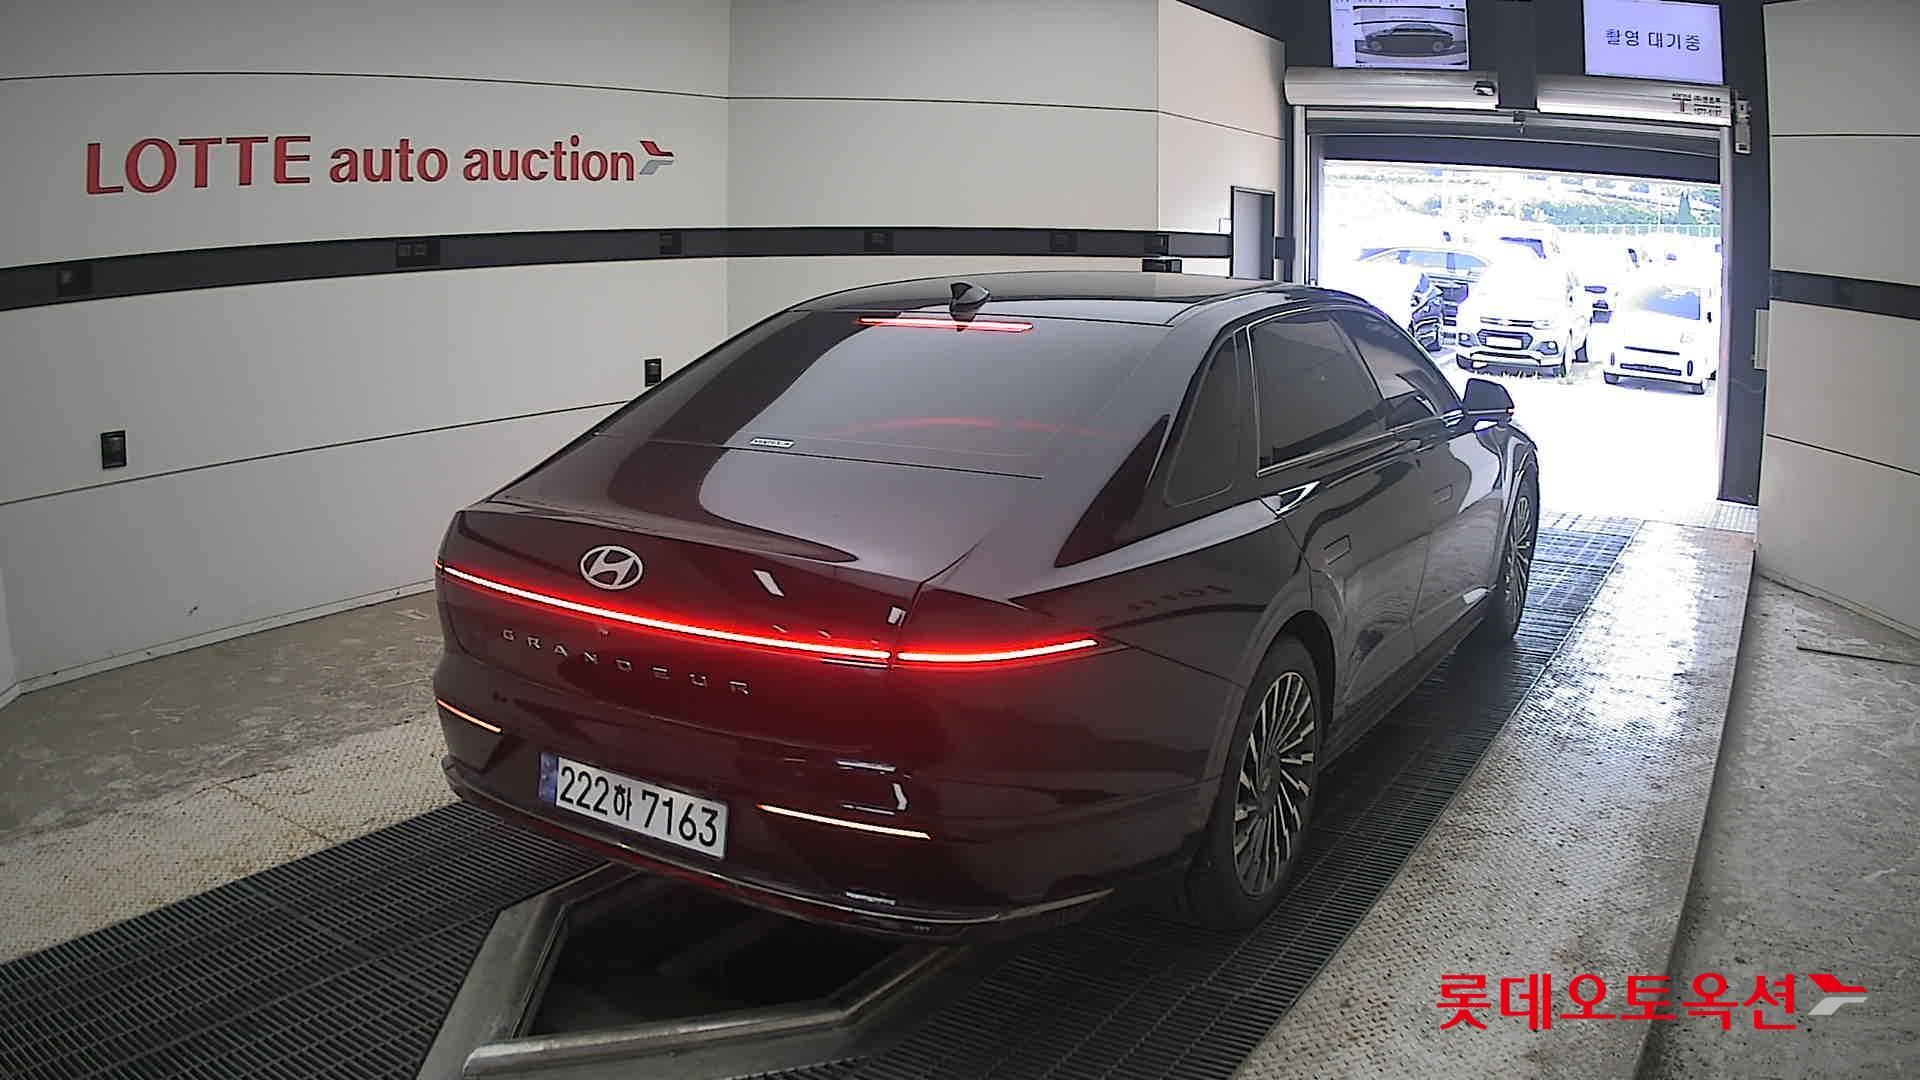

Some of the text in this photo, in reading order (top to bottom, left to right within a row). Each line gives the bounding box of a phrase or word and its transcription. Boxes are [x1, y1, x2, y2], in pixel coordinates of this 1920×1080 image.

[1606, 27, 1701, 52] 촬영 대기중
[87, 135, 636, 195] LOTTE auto auction
[501, 628, 751, 696] GRANDEUR
[559, 765, 719, 848] 222하 7163
